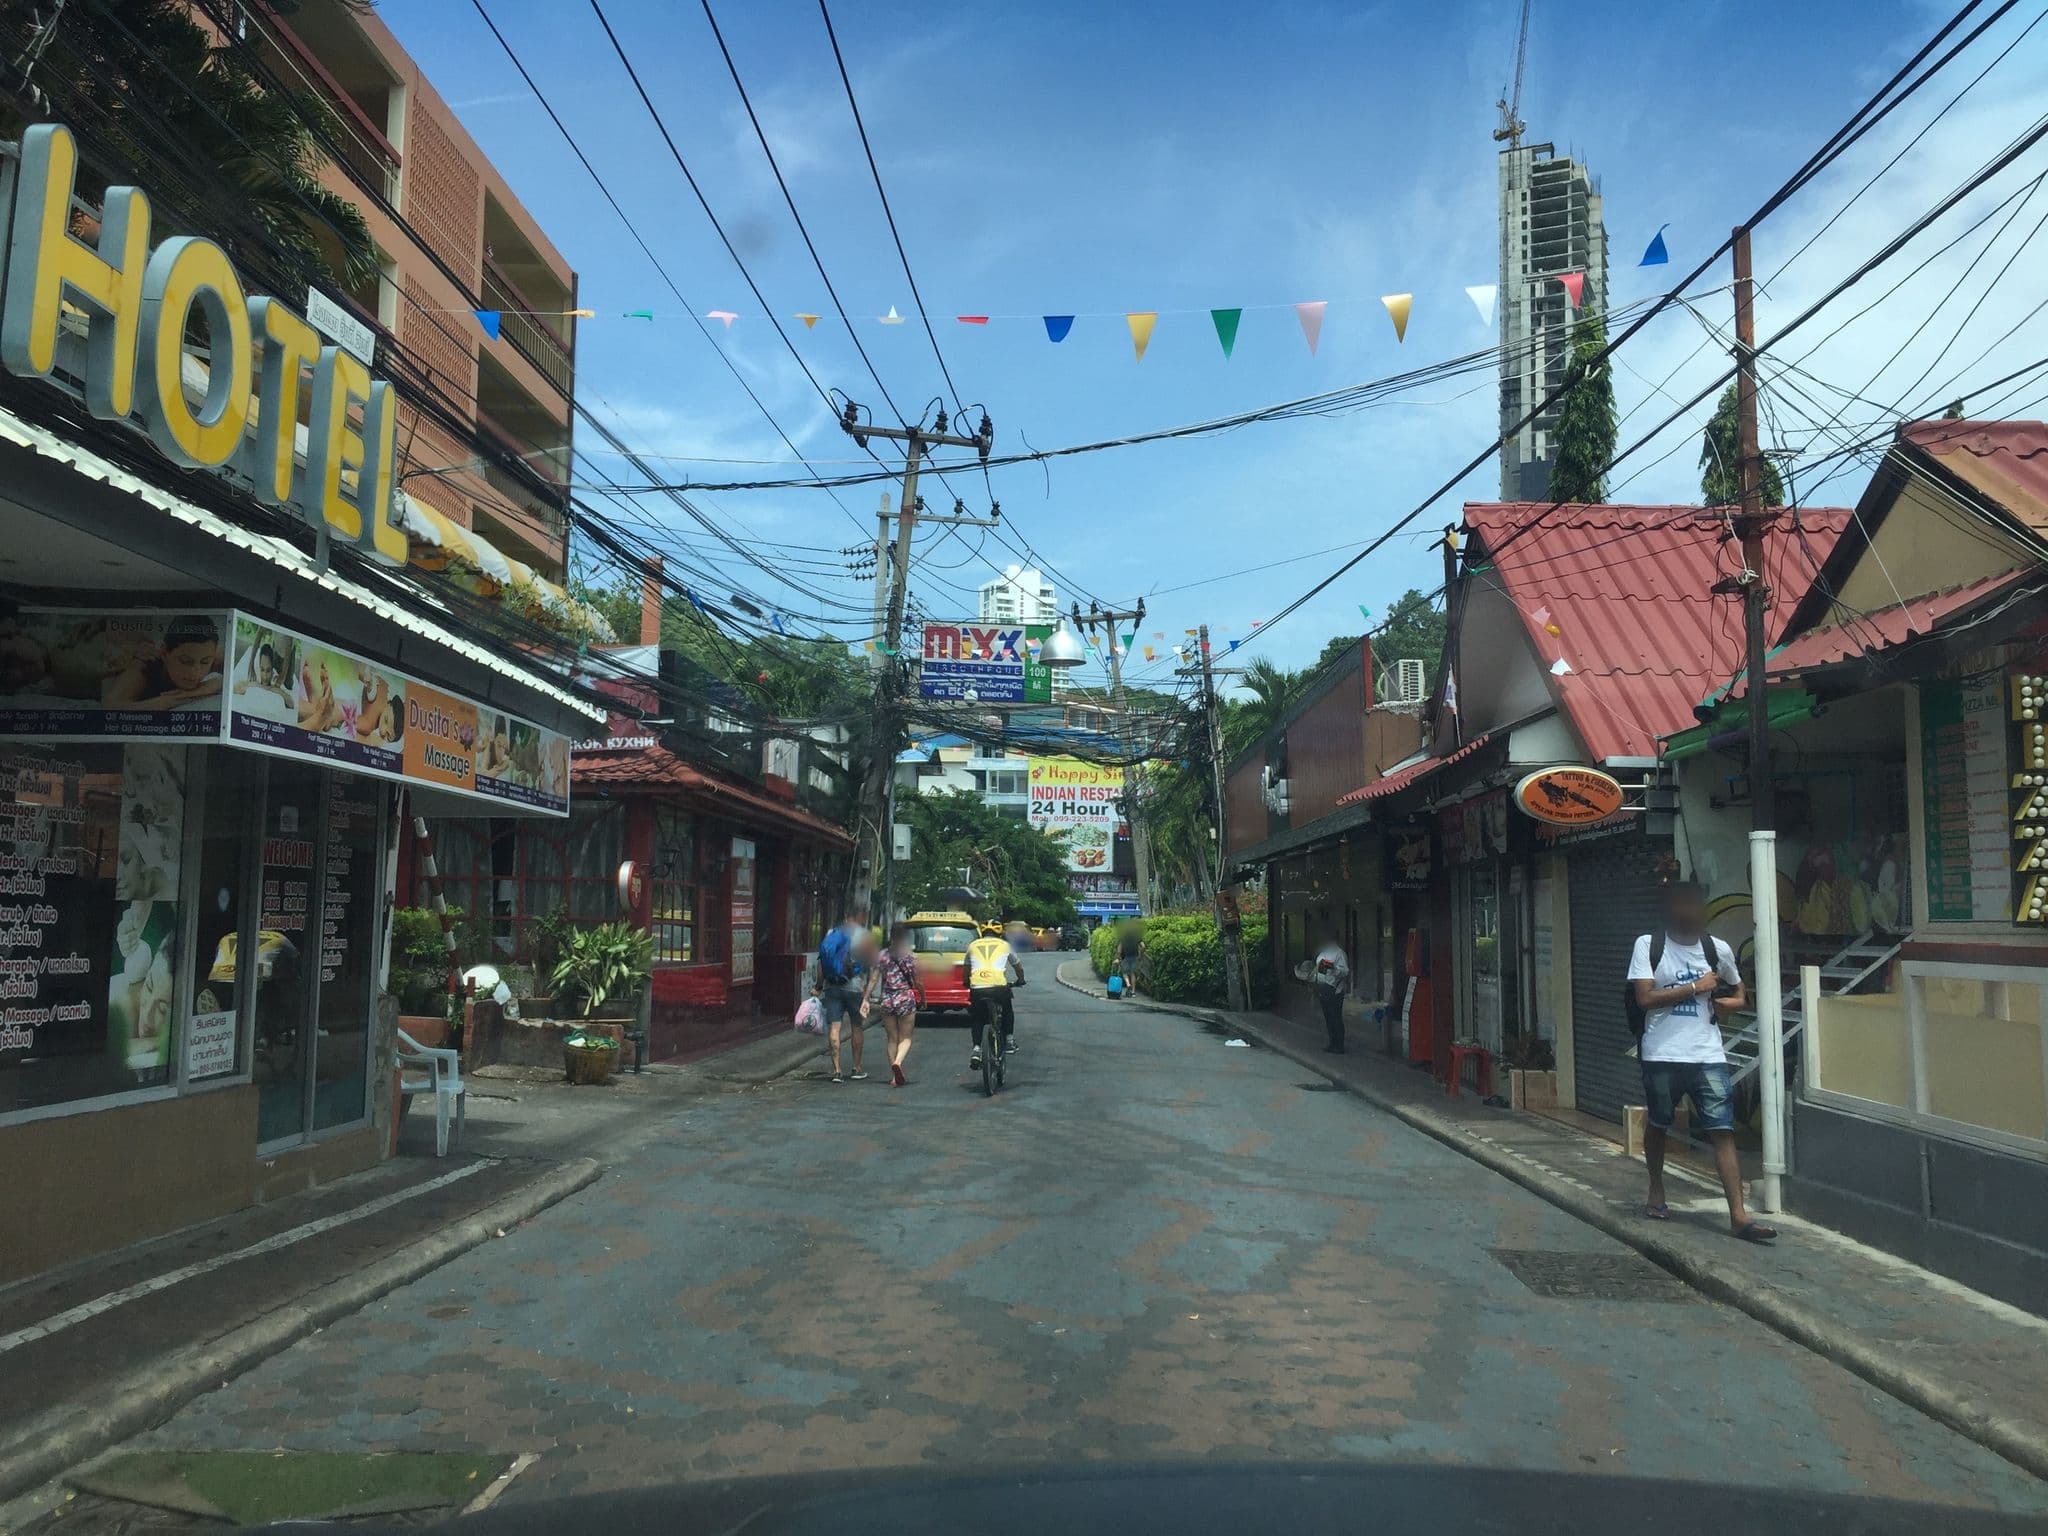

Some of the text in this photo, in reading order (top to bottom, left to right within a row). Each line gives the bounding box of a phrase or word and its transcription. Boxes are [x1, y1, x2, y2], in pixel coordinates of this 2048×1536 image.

[2, 123, 410, 567] HOTEL
[1029, 667, 1046, 678] 100
[170, 713, 185, 722] 300
[171, 725, 185, 734] 600
[409, 698, 471, 780] Dusita's Massage
[1049, 764, 1098, 784] Happy
[1031, 786, 1075, 801] INDIAN
[1031, 801, 1055, 815] 24
[1062, 801, 1109, 815] Hour
[263, 837, 314, 869] WELCOME
[5, 1007, 50, 1027] Massage
